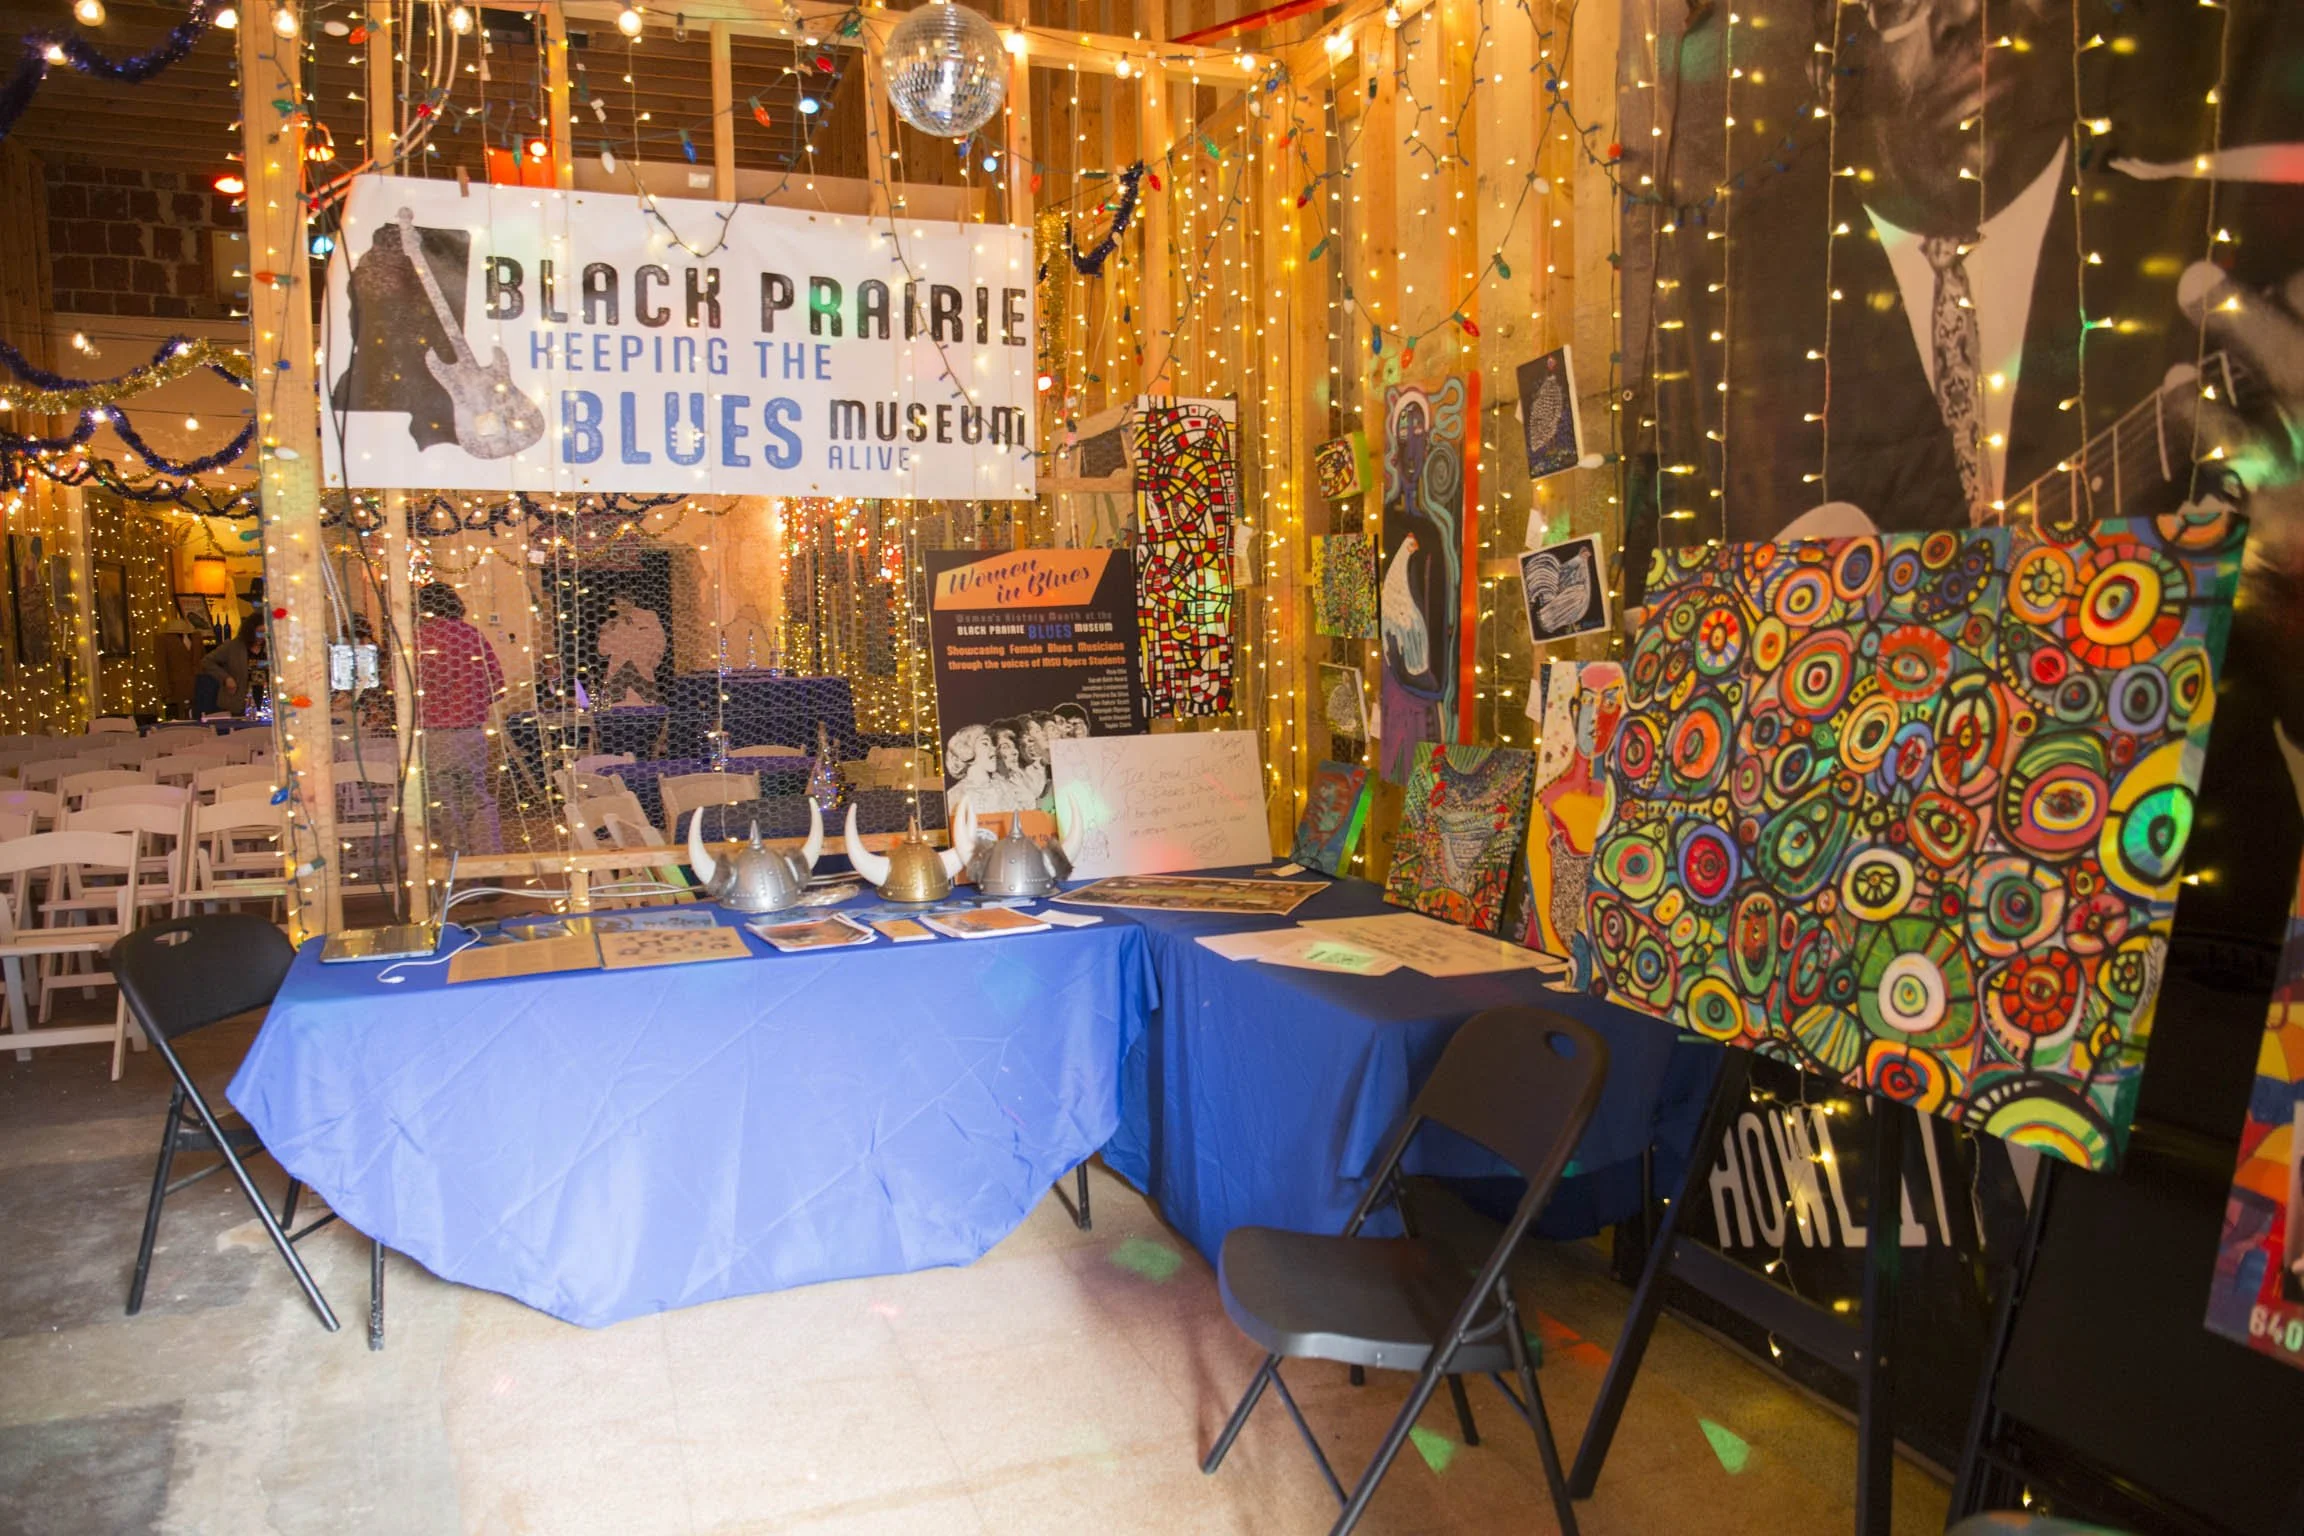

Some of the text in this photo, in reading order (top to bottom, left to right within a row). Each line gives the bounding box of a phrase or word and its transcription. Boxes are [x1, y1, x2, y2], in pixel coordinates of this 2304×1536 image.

[485, 255, 1026, 347] BLACK PRAIRIE
[530, 330, 832, 380] KEEPING THE
[561, 390, 1025, 470] BLUES MUSEUM
[828, 445, 909, 471] ALIVE
[950, 559, 1037, 594] Women
[997, 567, 1090, 603] in Blues
[957, 622, 1113, 640] BLACK PRAIRIE BLUES MUSEUM
[946, 641, 1125, 657] Showcasing Female Blues Musicians
[948, 656, 1126, 671] through the voices of MSU Opera Students
